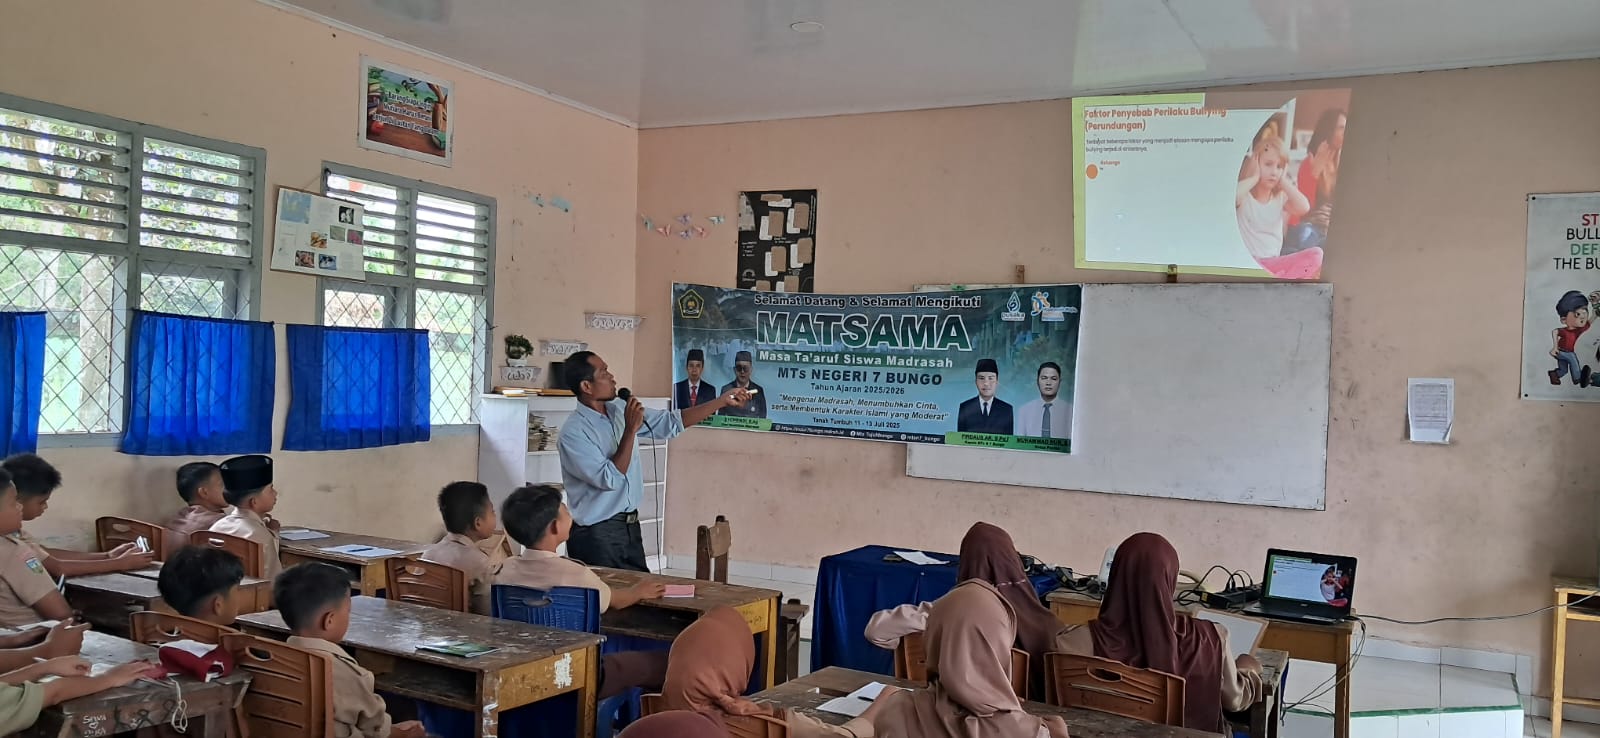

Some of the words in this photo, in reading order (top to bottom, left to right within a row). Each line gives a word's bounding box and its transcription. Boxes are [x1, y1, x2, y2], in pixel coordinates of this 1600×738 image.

[1084, 109, 1110, 118] Faktor
[1111, 108, 1153, 120] Penyebab
[1153, 106, 1189, 116] Perilaku
[1190, 106, 1227, 118] Bullying
[1085, 118, 1146, 132] (Perundungan)
[1581, 213, 1600, 226] ST
[1566, 227, 1600, 240] BULL
[1570, 243, 1600, 255] DEF
[1552, 257, 1582, 270] THE
[754, 294, 801, 306] Selamat
[803, 296, 846, 309] Datang
[849, 296, 858, 306] &
[862, 296, 912, 307] Selamat
[915, 295, 981, 310] Mengikuti
[756, 310, 973, 351] MATSAMA
[759, 350, 791, 361] Masa
[794, 352, 839, 363] Ta'aruf
[843, 354, 882, 365] Siswa
[886, 355, 953, 368] Madrasah
[777, 367, 806, 379] MTs
[811, 369, 867, 382] NEGERI
[872, 371, 881, 382] 7
[886, 372, 942, 385] BUNGO
[810, 383, 834, 391] Tahun
[836, 384, 861, 393] Ajaran
[864, 385, 905, 395] 2025/2026
[817, 396, 855, 406] Madrasah,
[857, 399, 914, 408] Menumbuhkan
[915, 401, 939, 410] Cinta,
[789, 404, 830, 414] Membentuk
[831, 407, 864, 416] Karakter
[889, 411, 910, 420] yang
[911, 411, 949, 421] Moderat"
